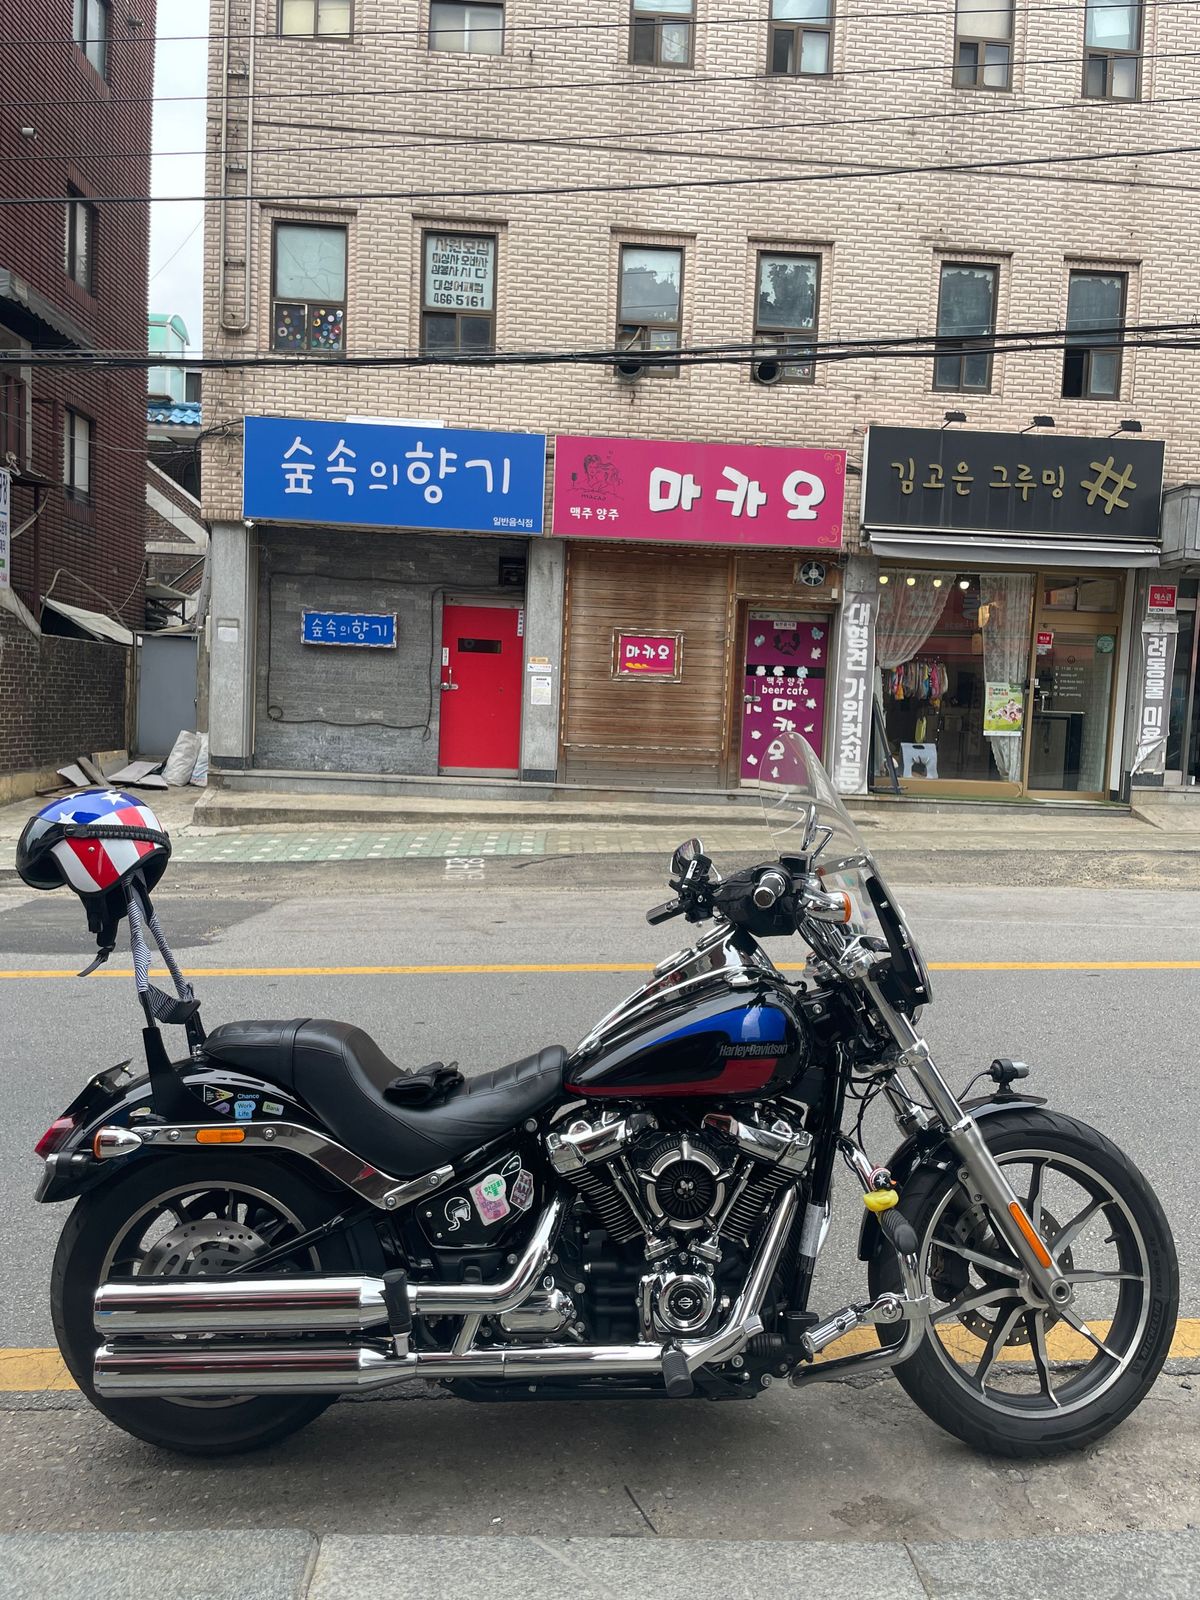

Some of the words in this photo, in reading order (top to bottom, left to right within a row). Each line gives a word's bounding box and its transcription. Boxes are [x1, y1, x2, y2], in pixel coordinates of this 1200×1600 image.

[435, 238, 489, 255] 사원모집
[432, 253, 460, 265] 미싱사
[433, 280, 484, 293] 대성어패럴
[891, 457, 975, 496] 김고은
[989, 464, 1065, 501] 그루밍
[649, 465, 826, 521] 마카오
[569, 507, 593, 520] 맥주
[596, 508, 620, 521] 양주
[492, 516, 534, 528] 일반음식점
[847, 603, 871, 672] 대형견
[626, 644, 670, 660] 마카오
[1144, 633, 1168, 700] 려동물
[762, 685, 784, 695] beer
[786, 685, 809, 696] cafe
[265, 1104, 280, 1112] Bank
